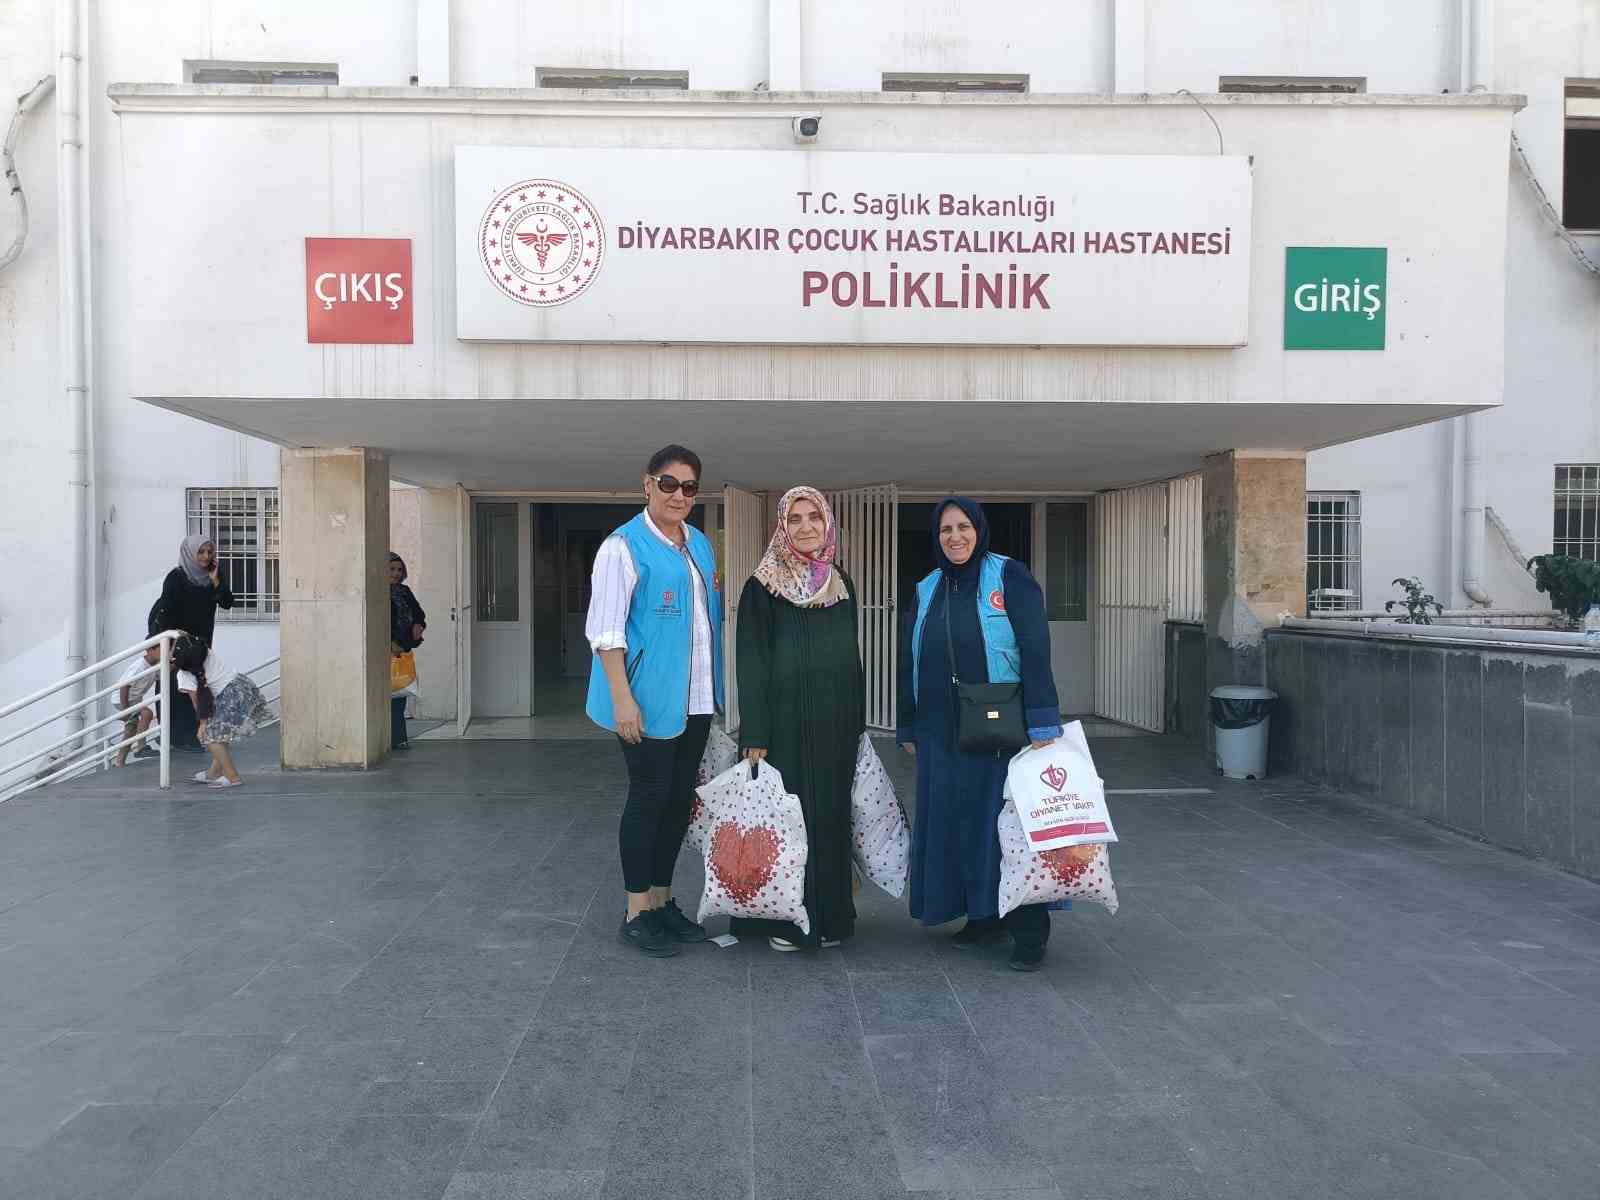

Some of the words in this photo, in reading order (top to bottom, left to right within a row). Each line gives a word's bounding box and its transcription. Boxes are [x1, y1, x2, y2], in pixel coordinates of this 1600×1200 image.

[797, 191, 844, 214] T.C.
[853, 192, 930, 221] Sağlık
[938, 194, 1054, 222] Bakanlığı
[617, 221, 779, 250] DİYARBAKIR
[787, 228, 878, 254] ÇOCUK
[886, 229, 1075, 253] HASTALIKLARI
[1084, 227, 1231, 255] HASTANESİ
[314, 272, 404, 310] ÇIKIŞ
[802, 262, 1050, 309] POLİKLİNİK
[1294, 277, 1381, 321] GİRİŞ
